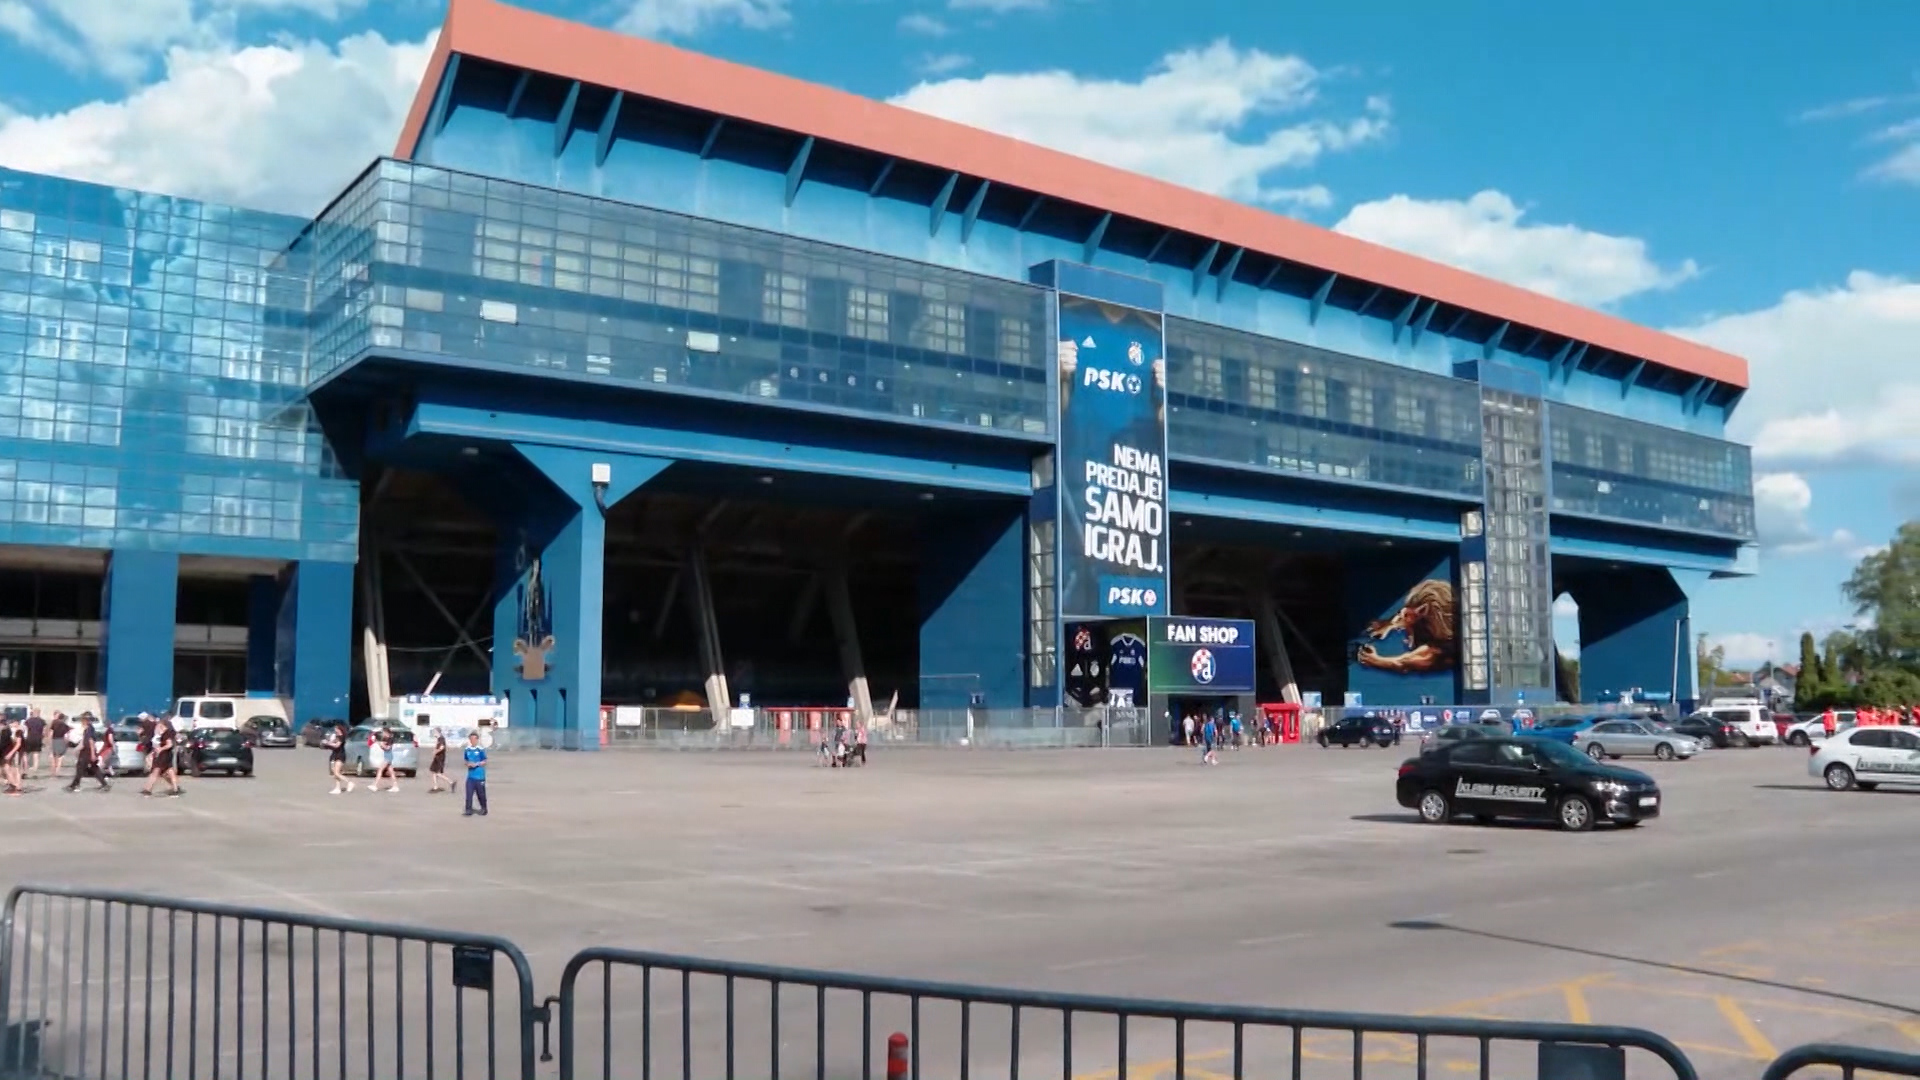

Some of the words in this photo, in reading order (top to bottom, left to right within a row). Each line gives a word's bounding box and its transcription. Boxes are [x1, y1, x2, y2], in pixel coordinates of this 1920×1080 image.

[1084, 367, 1126, 392] PSK
[1114, 443, 1161, 477] NEMA
[1085, 460, 1162, 501] PREDAJE!
[1085, 486, 1162, 536] SAMO
[1084, 522, 1163, 573] IGRAJ.
[1108, 587, 1144, 606] PSK
[1167, 624, 1197, 642] FAN
[1199, 626, 1239, 644] SHOP
